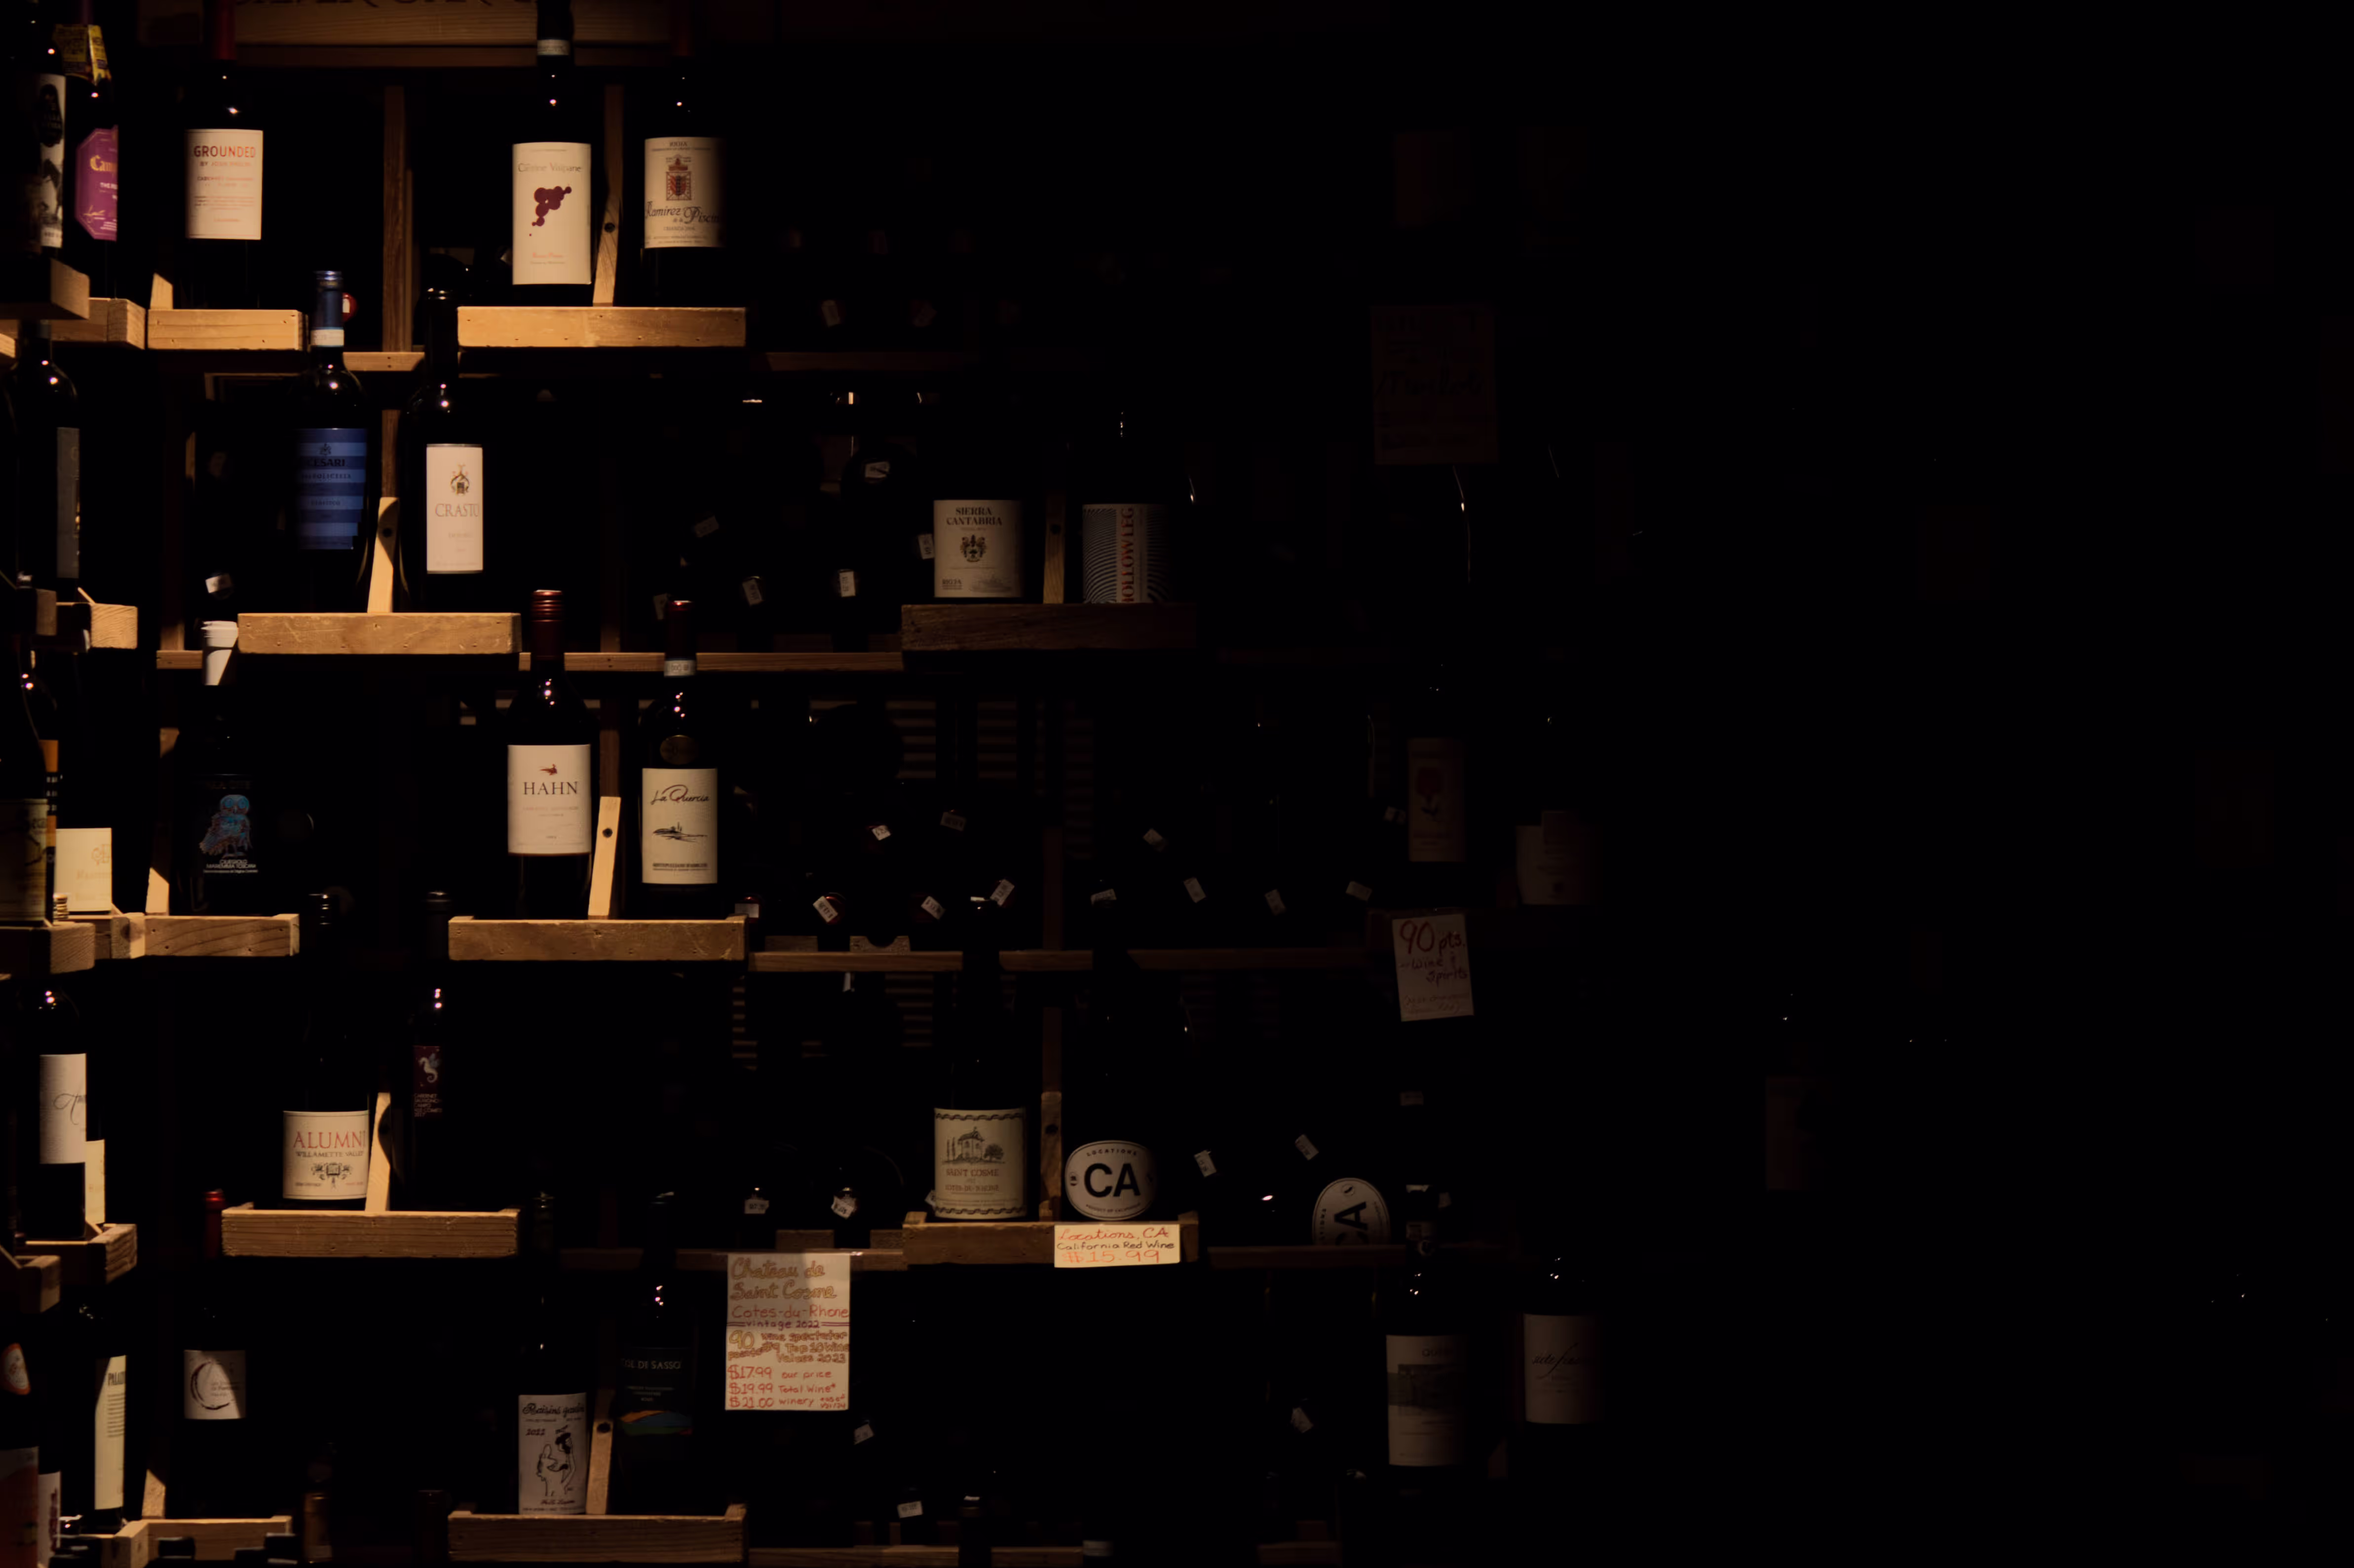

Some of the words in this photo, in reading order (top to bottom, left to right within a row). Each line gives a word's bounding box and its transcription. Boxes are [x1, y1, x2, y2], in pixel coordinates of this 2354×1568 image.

[193, 146, 256, 157] GROUNDED
[955, 507, 992, 515] SIERRA
[946, 518, 1003, 526] CANTABRIA
[523, 782, 578, 795] HAHN
[1400, 920, 1435, 955] 90
[293, 1131, 366, 1149] ALUMNI
[1086, 1148, 1137, 1157] LOCATIONS
[946, 1168, 968, 1177] SAINT
[970, 1168, 999, 1177] COSME
[1084, 1162, 1141, 1198] CA
[1058, 1228, 1140, 1240] Locations,
[1142, 1227, 1169, 1238] CA
[1057, 1241, 1119, 1250] California
[1145, 1240, 1175, 1248] Wine
[1062, 1249, 1160, 1264] $15.99
[731, 1257, 798, 1279] Chateau
[804, 1260, 826, 1278] de
[730, 1282, 779, 1300] Saint
[782, 1279, 837, 1300] Cosme
[731, 1304, 850, 1318] Cotes-du-Rhone
[746, 1320, 792, 1331] vintage
[728, 1330, 755, 1349] 90
[785, 1343, 808, 1354] Top
[817, 1353, 846, 1363] 2023
[638, 1361, 648, 1369] DI
[650, 1360, 682, 1370] SASSO
[727, 1364, 772, 1380] $17.99
[803, 1371, 832, 1380] price
[728, 1382, 773, 1395] $19.99
[778, 1384, 803, 1394] Total
[729, 1396, 774, 1409] $21.00
[778, 1398, 814, 1408] winery
